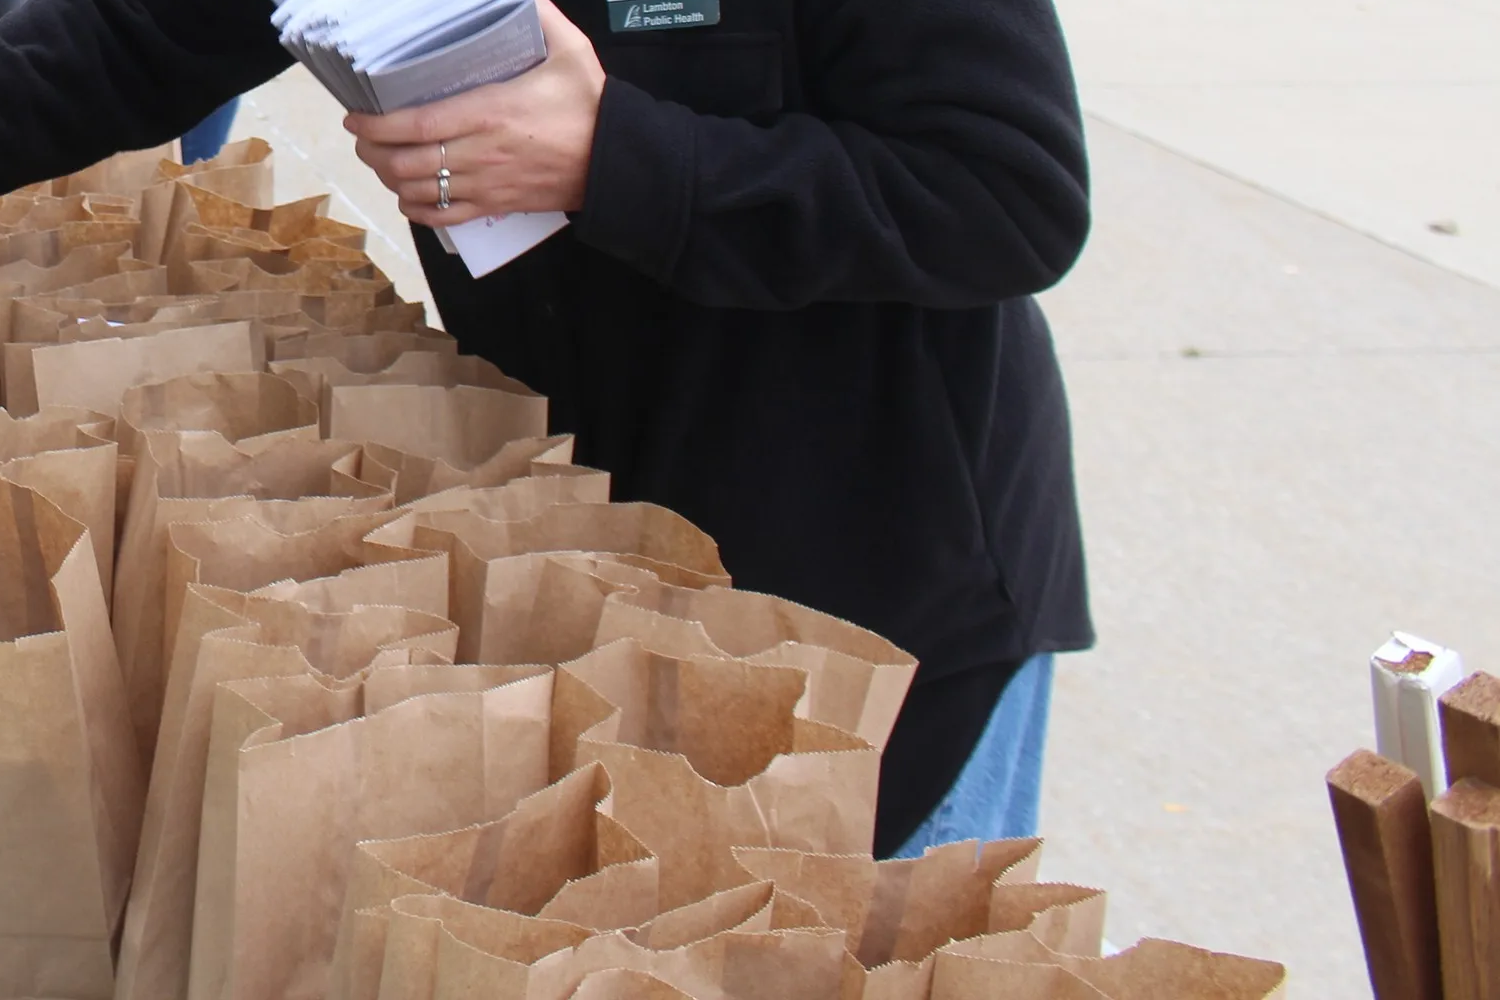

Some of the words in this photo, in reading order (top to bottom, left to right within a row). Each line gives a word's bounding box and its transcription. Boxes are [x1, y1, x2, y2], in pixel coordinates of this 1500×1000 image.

[643, 2, 683, 12] Lambton
[643, 16, 672, 26] Public
[674, 12, 704, 23] Health
